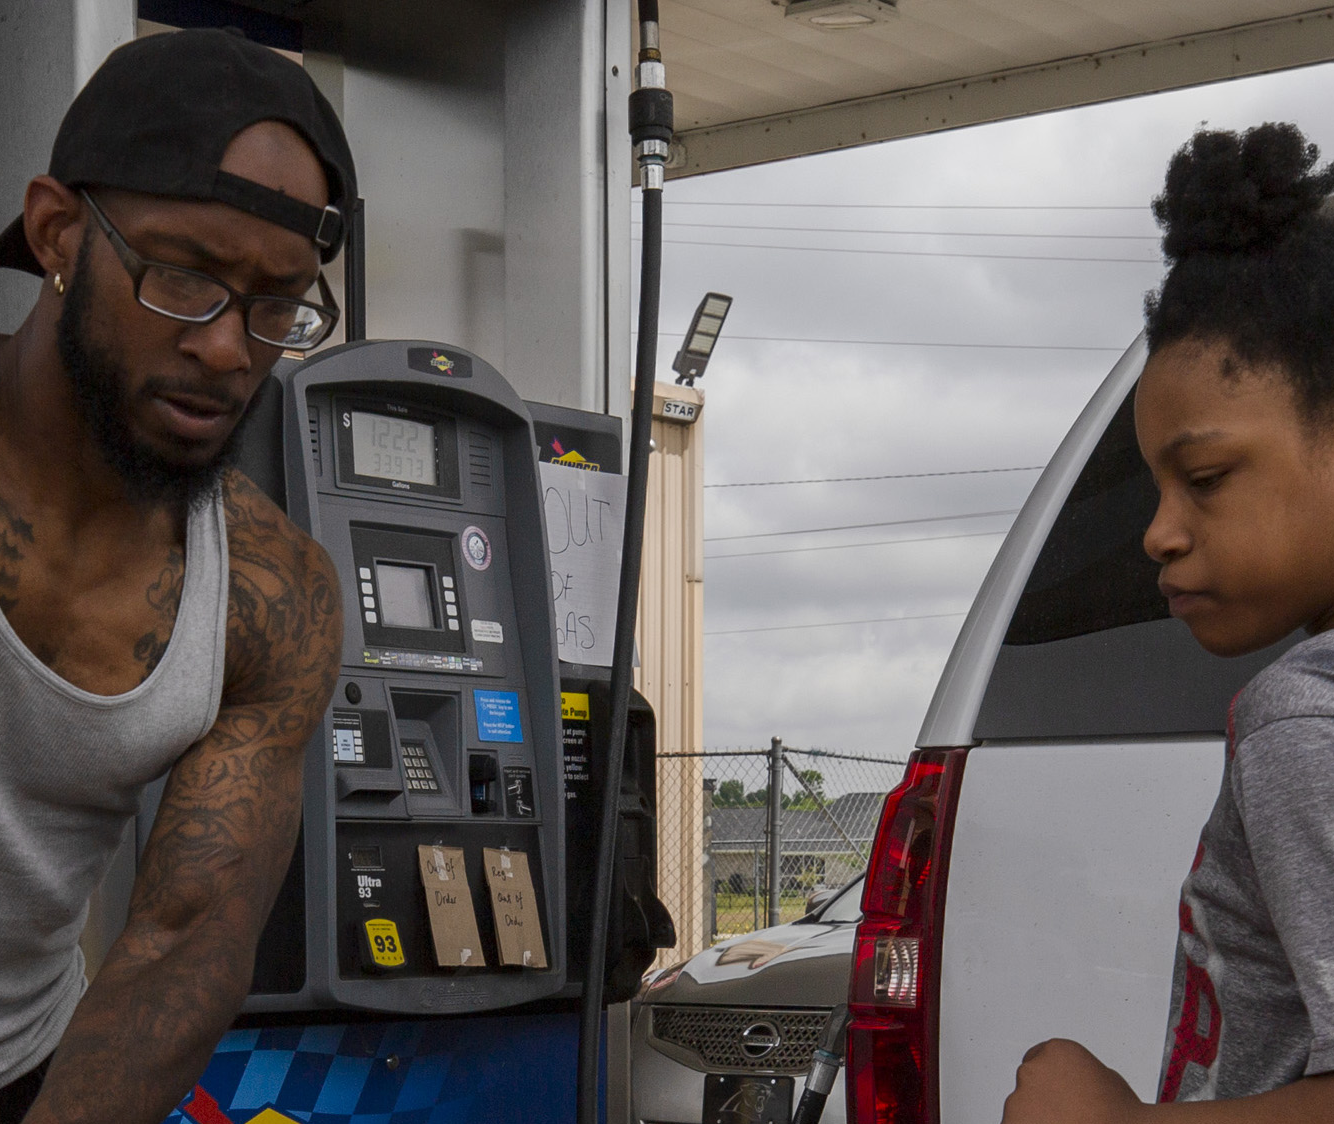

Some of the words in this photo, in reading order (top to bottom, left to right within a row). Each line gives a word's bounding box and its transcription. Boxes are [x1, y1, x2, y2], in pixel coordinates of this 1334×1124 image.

[664, 402, 694, 417] STAR
[544, 487, 610, 554] OUT
[569, 707, 587, 719] Pump
[357, 875, 382, 888] Ultra
[358, 888, 372, 898] 93
[435, 890, 457, 907] Order
[373, 935, 397, 953] 93
